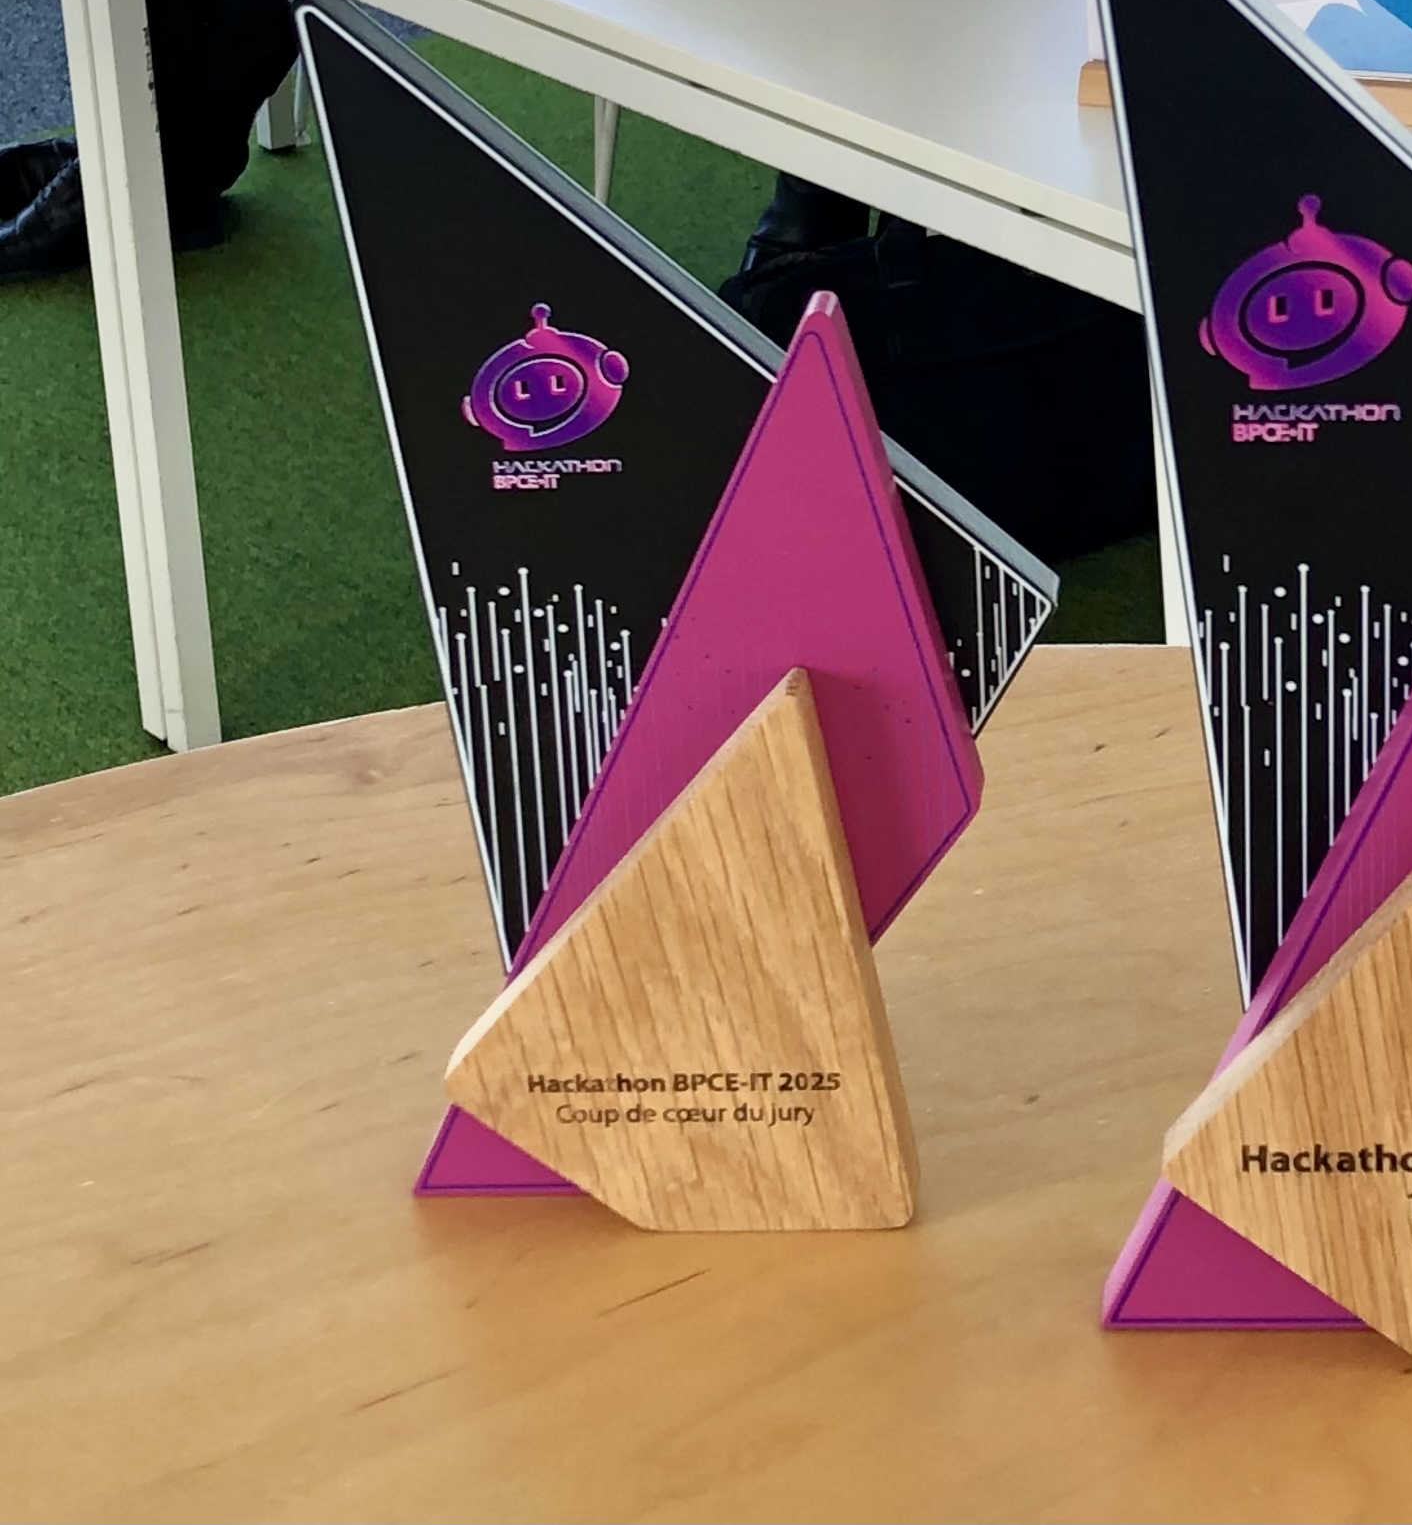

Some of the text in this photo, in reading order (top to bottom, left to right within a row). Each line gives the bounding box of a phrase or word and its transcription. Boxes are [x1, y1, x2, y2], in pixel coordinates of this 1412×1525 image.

[1232, 403, 1401, 421] HACKATHON
[1232, 423, 1319, 442] BPCE-IT
[492, 459, 622, 473] HACKATHON
[492, 474, 560, 489] BPCE-IT
[527, 1071, 841, 1093] Hackathon BPCE-IT 2025
[556, 1102, 815, 1127] Coup de cœur du jury
